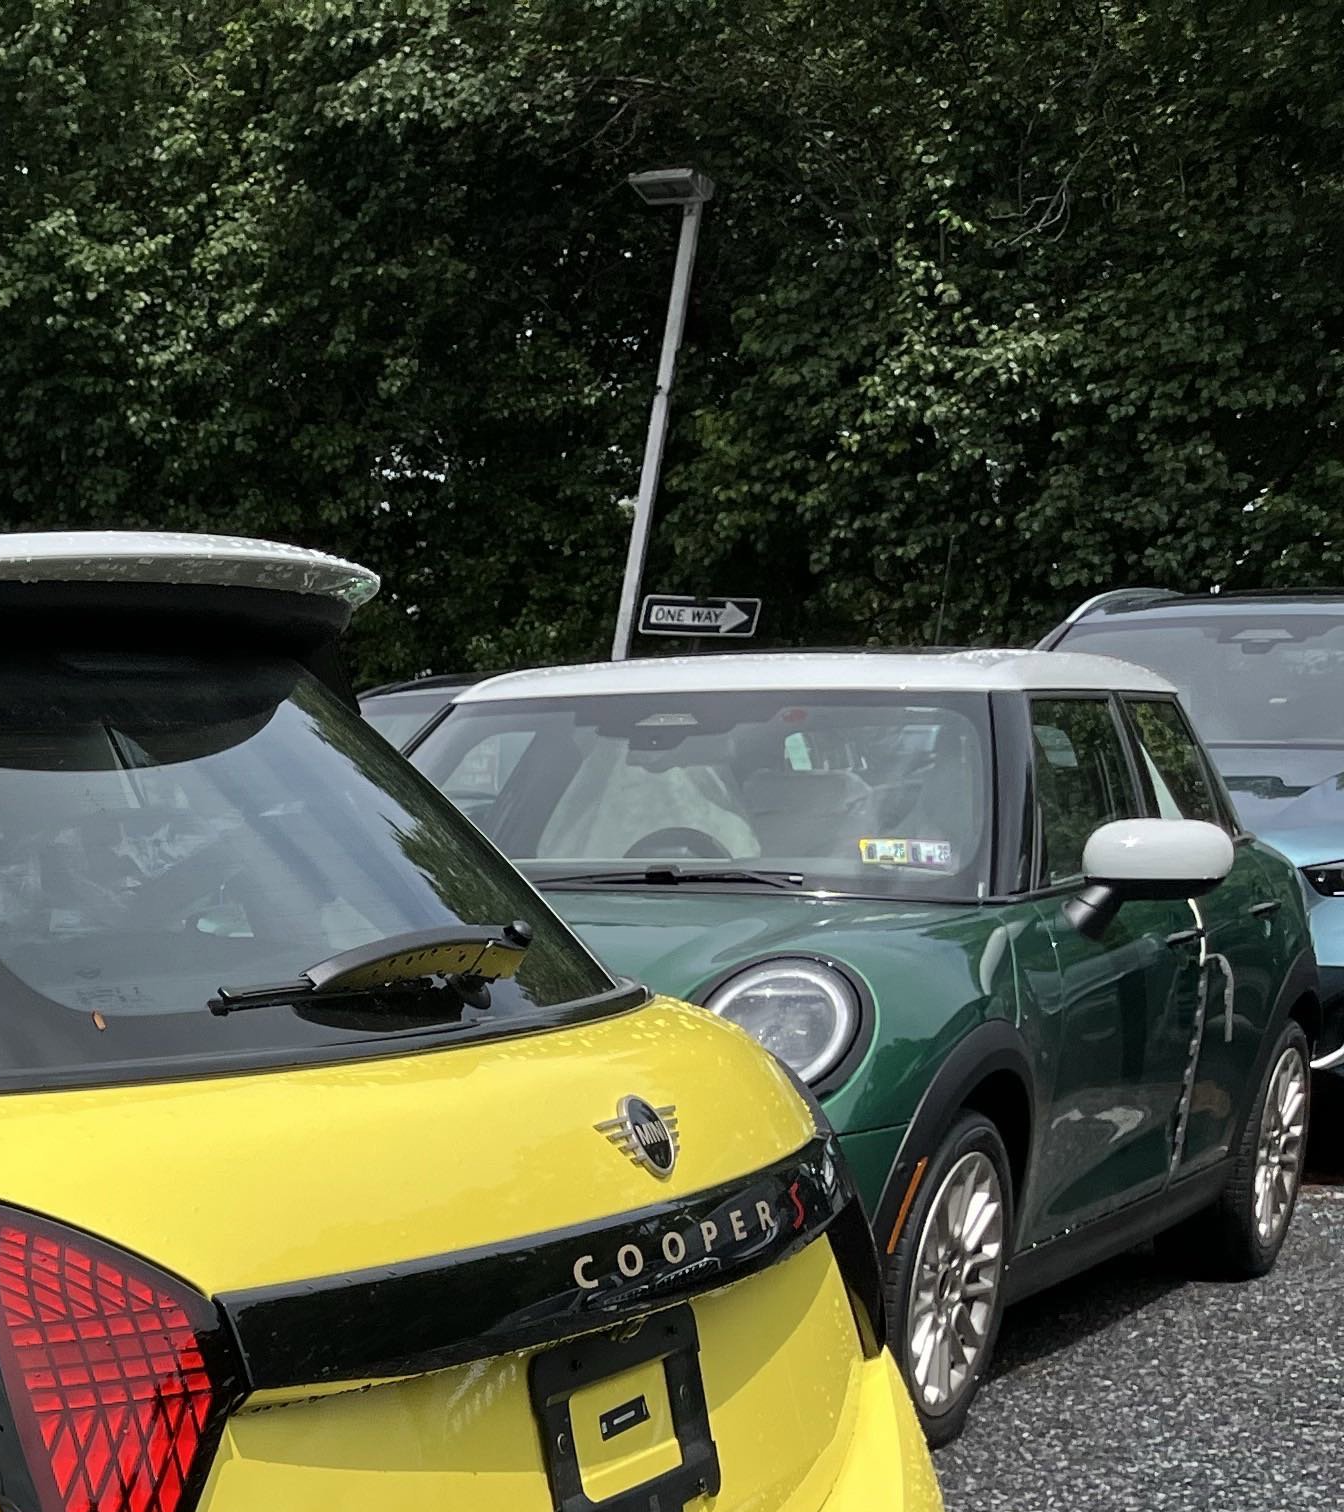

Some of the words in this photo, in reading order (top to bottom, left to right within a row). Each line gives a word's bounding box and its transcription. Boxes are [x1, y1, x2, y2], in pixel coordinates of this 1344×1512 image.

[655, 607, 685, 621] ONE
[691, 609, 724, 624] WAY
[634, 1120, 669, 1146] MINI
[573, 1201, 777, 1289] COOPER
[789, 1181, 806, 1230] S
